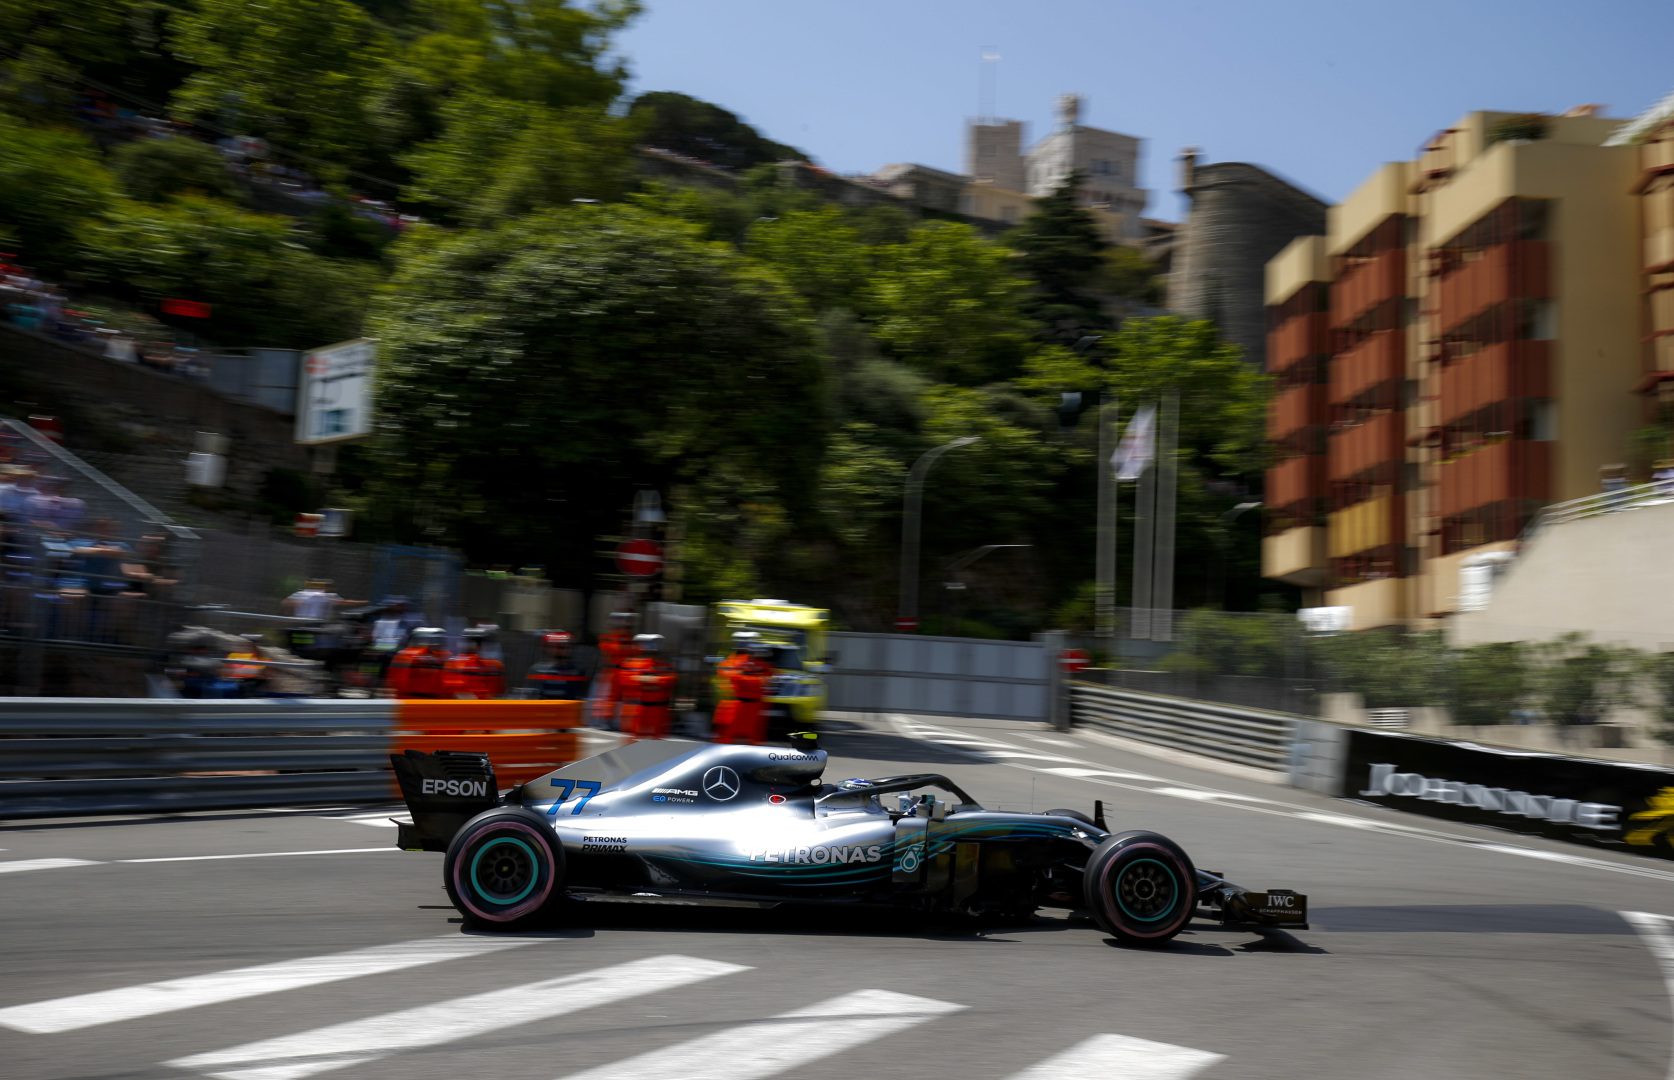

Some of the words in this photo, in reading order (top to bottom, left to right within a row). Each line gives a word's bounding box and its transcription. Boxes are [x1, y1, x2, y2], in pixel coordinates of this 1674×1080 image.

[768, 752, 819, 762] Qualcomm
[421, 778, 487, 797] EPSON
[667, 788, 699, 797] AMG
[546, 778, 602, 816] 77
[583, 835, 628, 844] PETRONAS
[581, 844, 628, 853] PRIMAX
[748, 844, 882, 865] PETRONAS
[1266, 894, 1295, 907] IWC
[1258, 907, 1303, 915] SCHAFFHAUSEN
